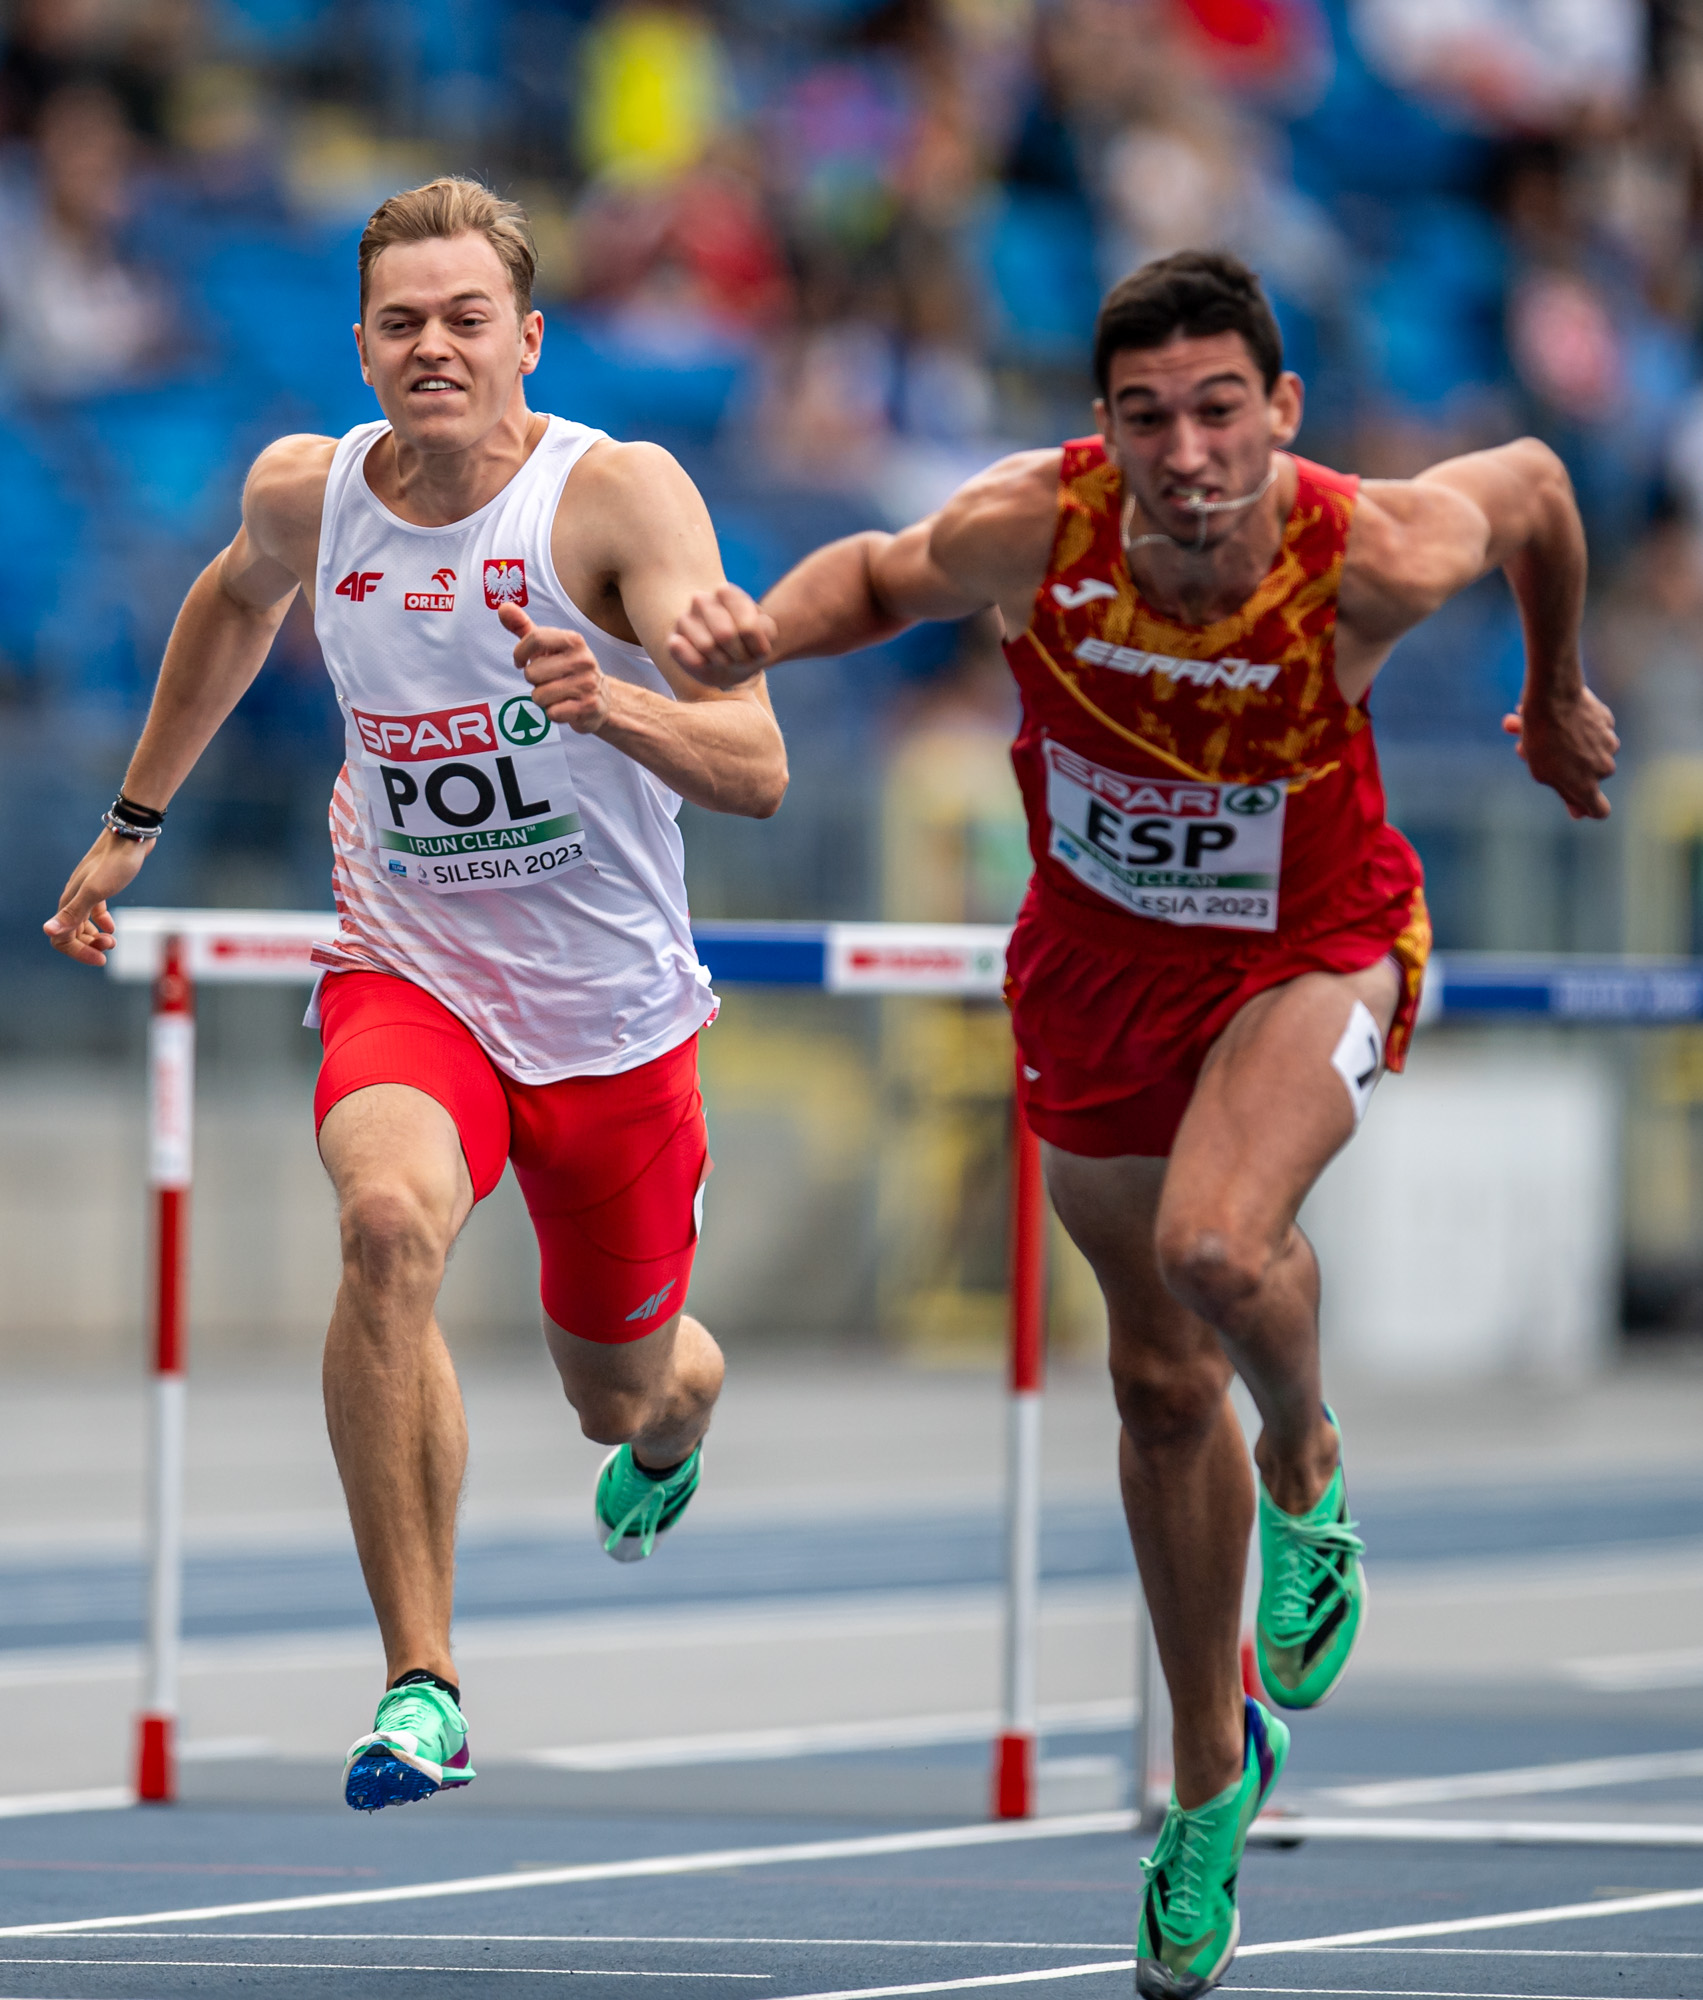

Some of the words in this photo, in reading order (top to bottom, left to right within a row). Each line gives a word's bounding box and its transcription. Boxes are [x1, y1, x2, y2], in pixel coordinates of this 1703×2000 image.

[335, 571, 384, 602] 4F
[407, 594, 454, 609] ORLEN
[1074, 636, 1280, 690] ESPAÑA
[358, 711, 492, 755] SPAR
[380, 755, 552, 828] POL
[1056, 754, 1214, 813] SPAR
[416, 836, 459, 855] RUN
[1087, 798, 1237, 868] ESP
[433, 858, 521, 884] SILESIA
[524, 843, 583, 875] 2023
[1205, 896, 1270, 917] 2023
[625, 1278, 677, 1321] 4F
